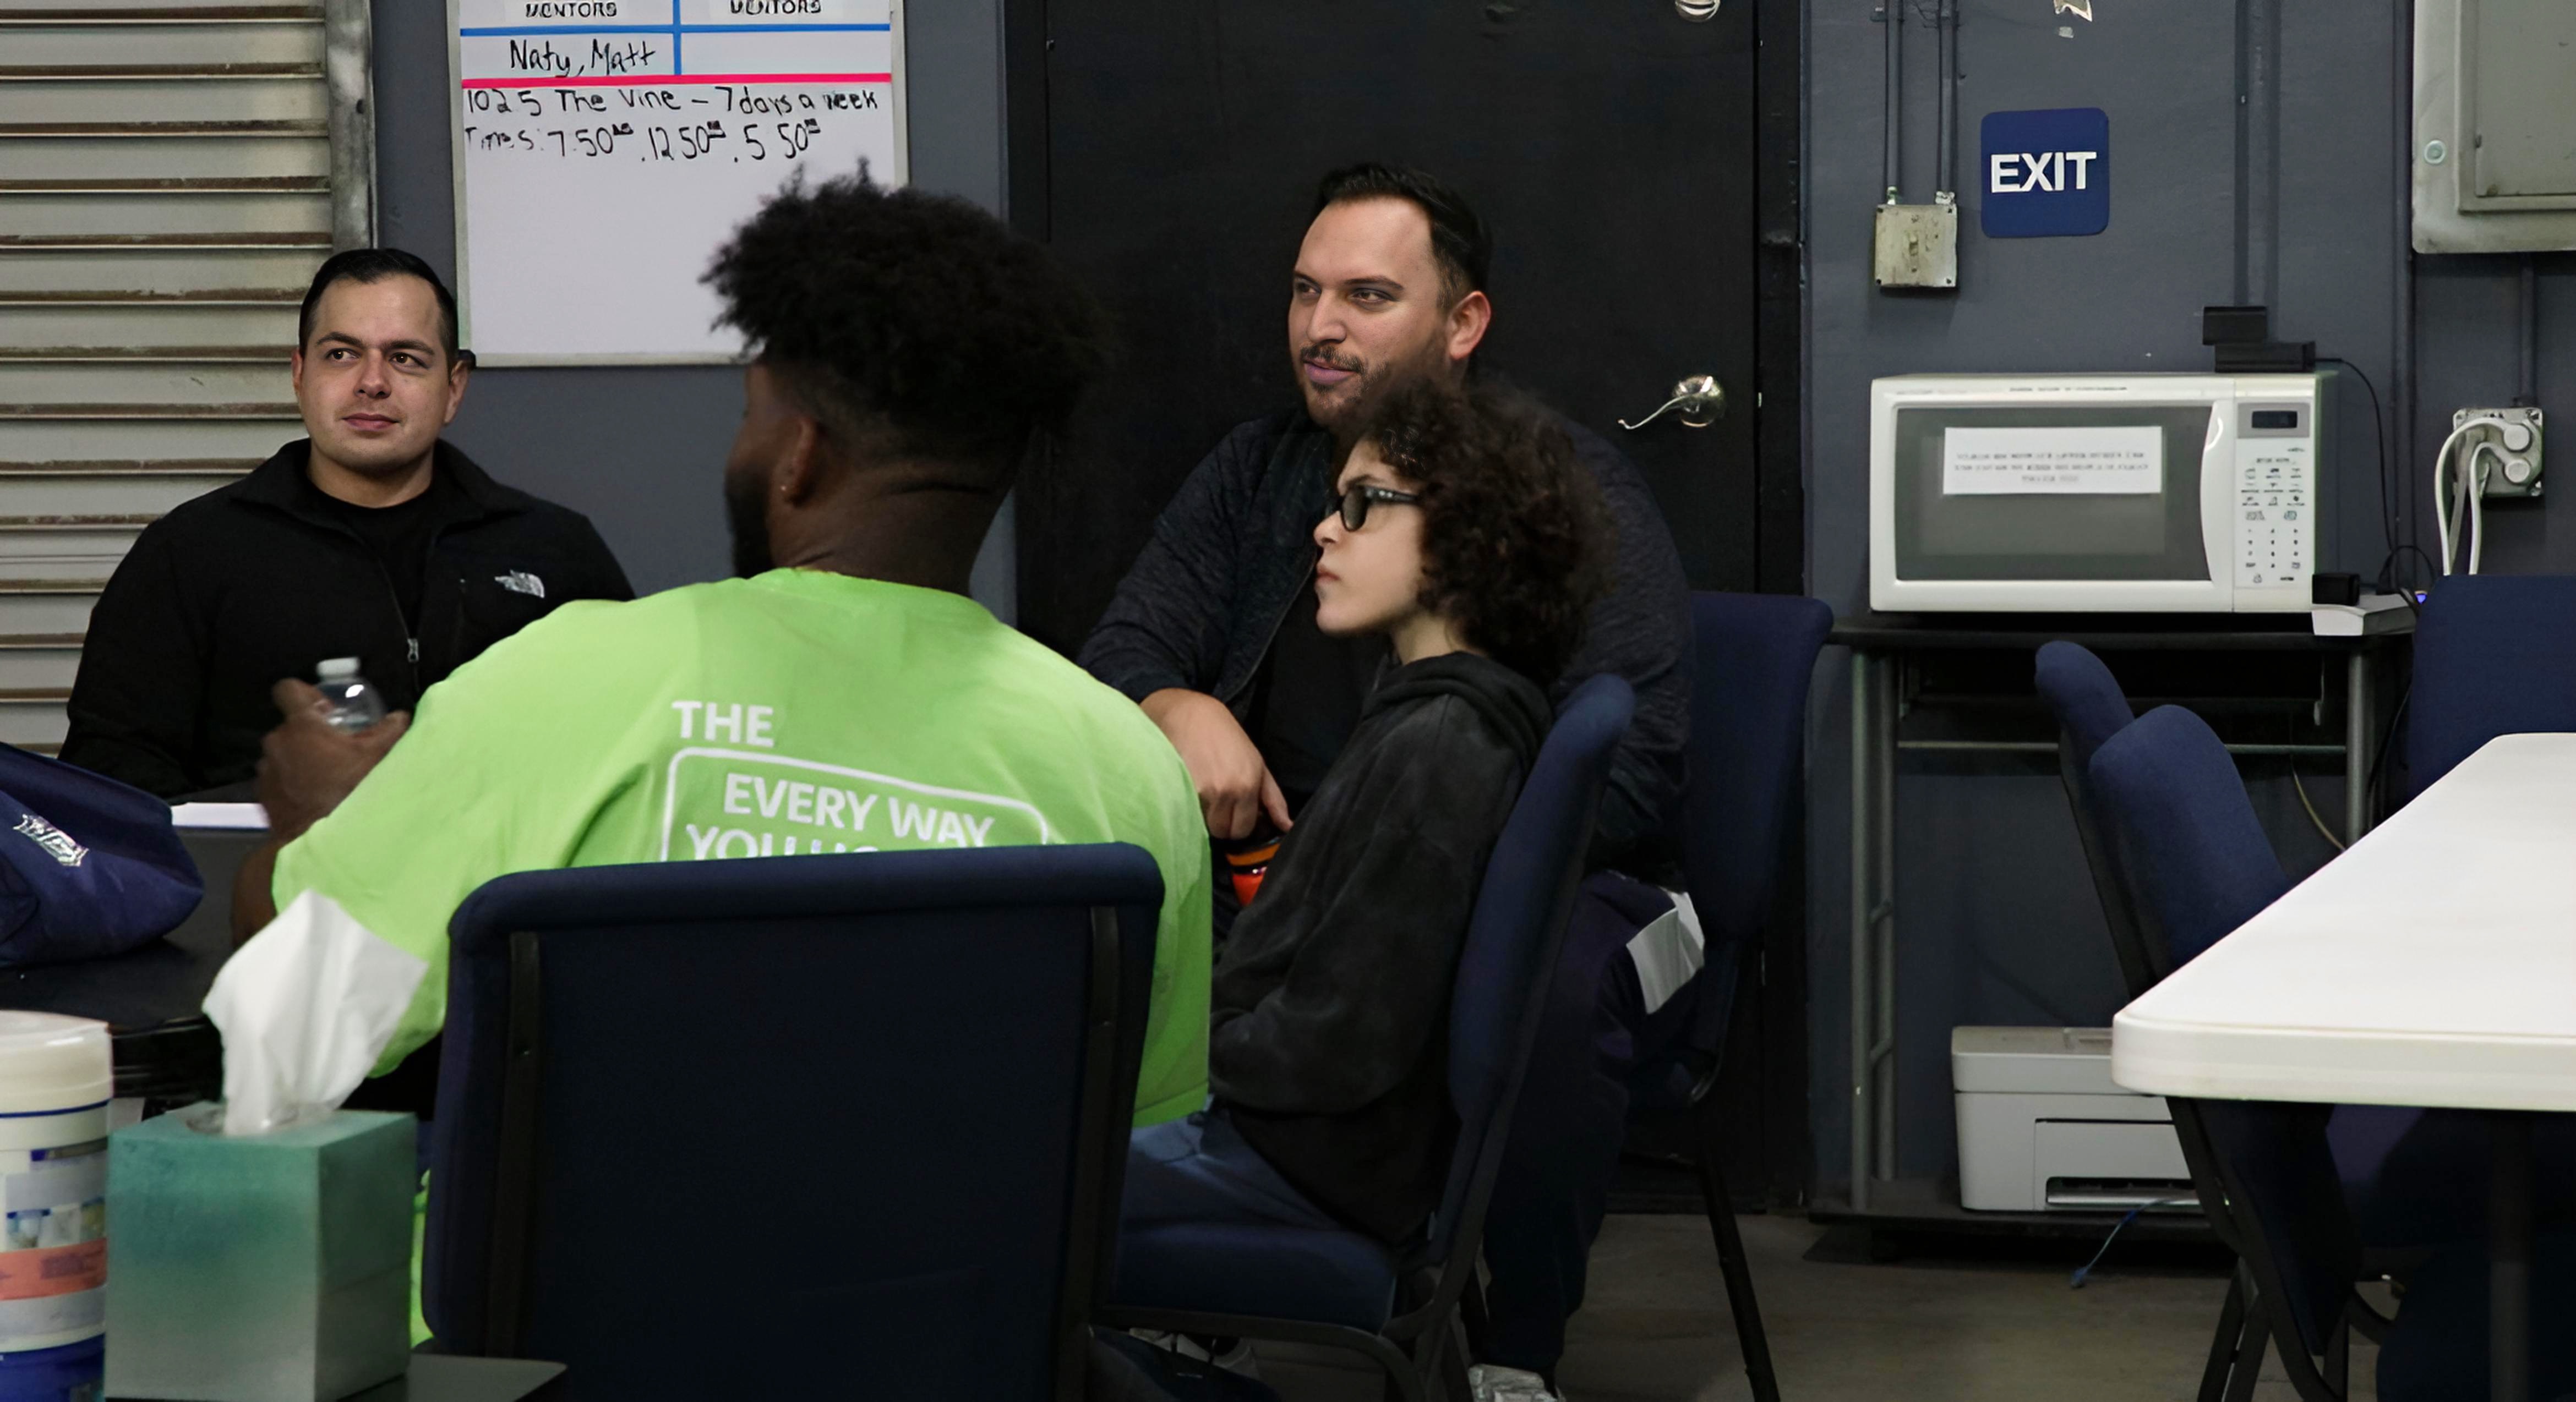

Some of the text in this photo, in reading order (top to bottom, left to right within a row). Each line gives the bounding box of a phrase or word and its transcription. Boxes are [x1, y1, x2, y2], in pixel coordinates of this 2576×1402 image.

[591, 39, 656, 75] Matt
[555, 89, 607, 111] The
[619, 89, 681, 110] Vine
[798, 94, 815, 109] a
[1991, 151, 2097, 193] EXIT
[672, 700, 774, 747] THE
[724, 773, 995, 848] EVERY WAY
